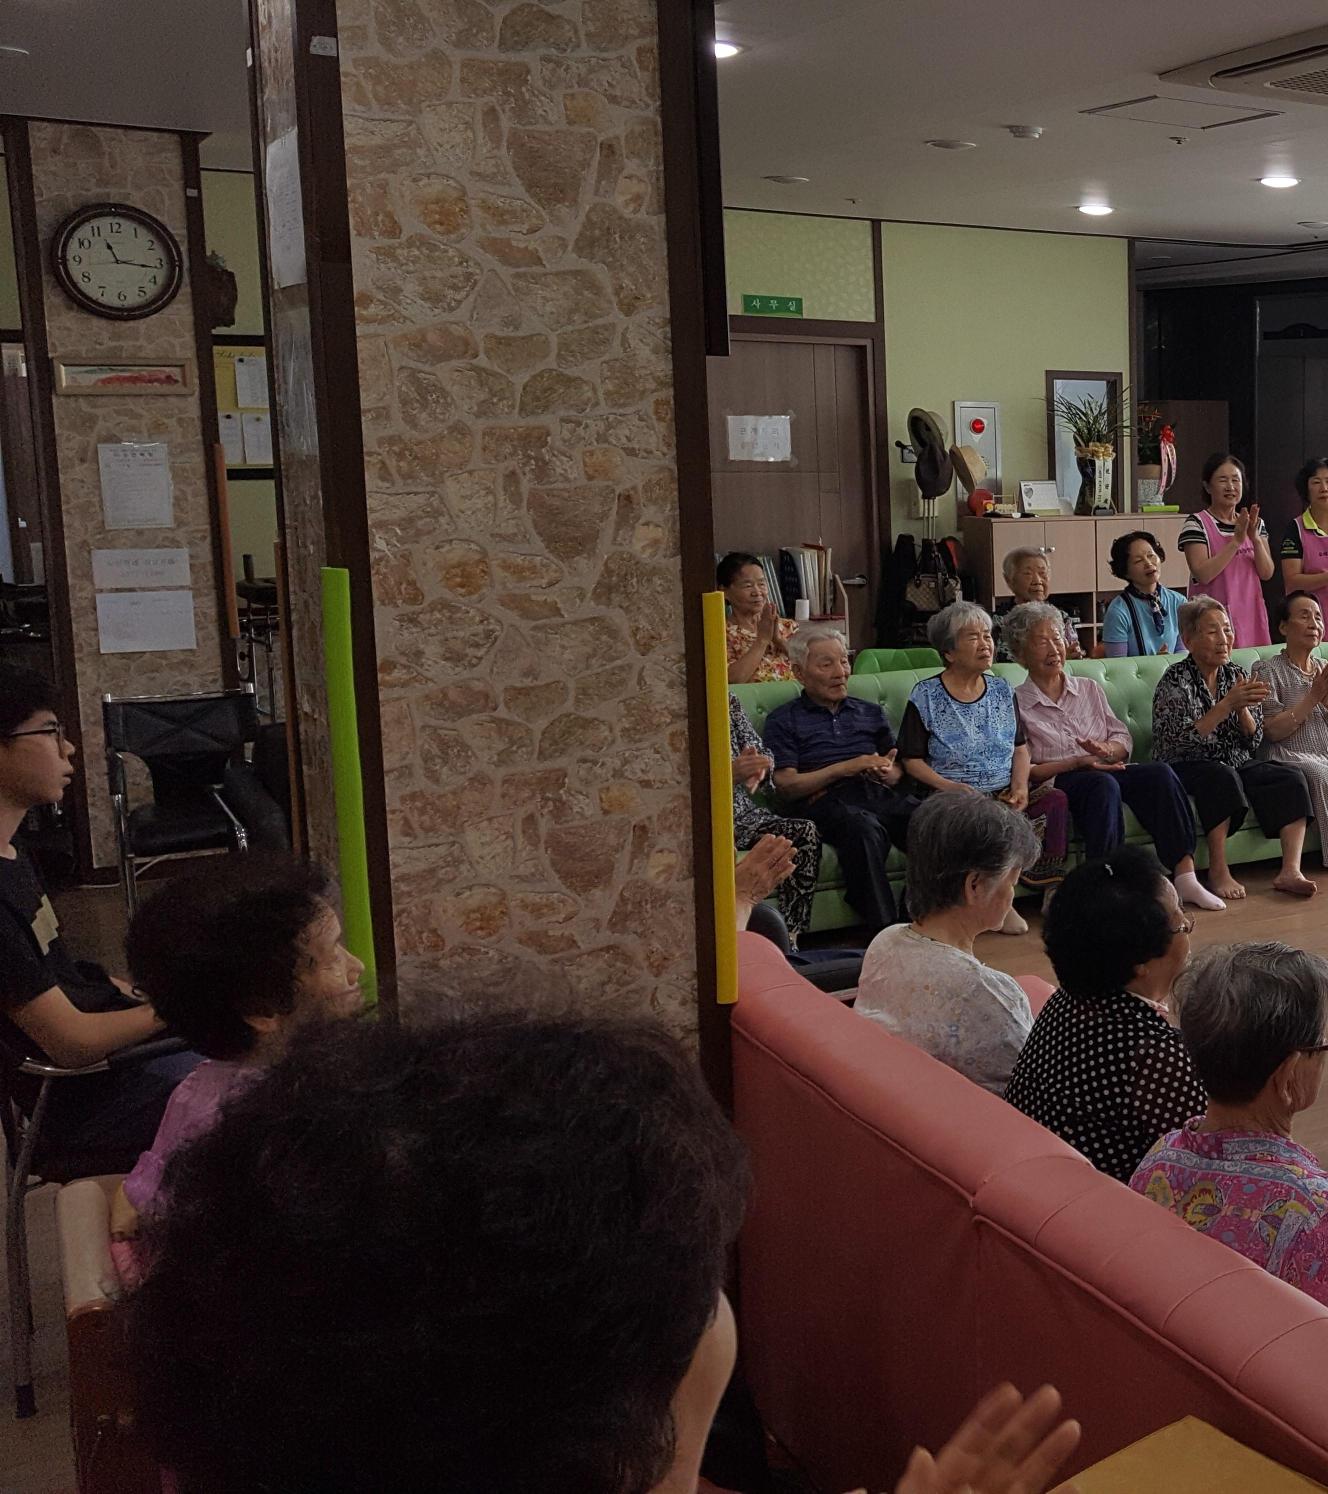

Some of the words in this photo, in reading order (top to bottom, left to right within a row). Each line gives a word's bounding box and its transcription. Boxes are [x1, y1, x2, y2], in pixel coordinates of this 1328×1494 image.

[91, 225, 101, 237] 11
[109, 222, 121, 233] 12
[133, 227, 138, 239] 1
[78, 238, 91, 250] 10
[147, 239, 155, 251] 2
[72, 254, 82, 266] 9
[156, 257, 163, 269] 3
[81, 271, 91, 283] 8
[149, 275, 157, 285] 4
[98, 285, 106, 297] 7
[118, 290, 127, 302] 6
[138, 286, 147, 298] 5
[751, 297, 796, 312] 사무실
